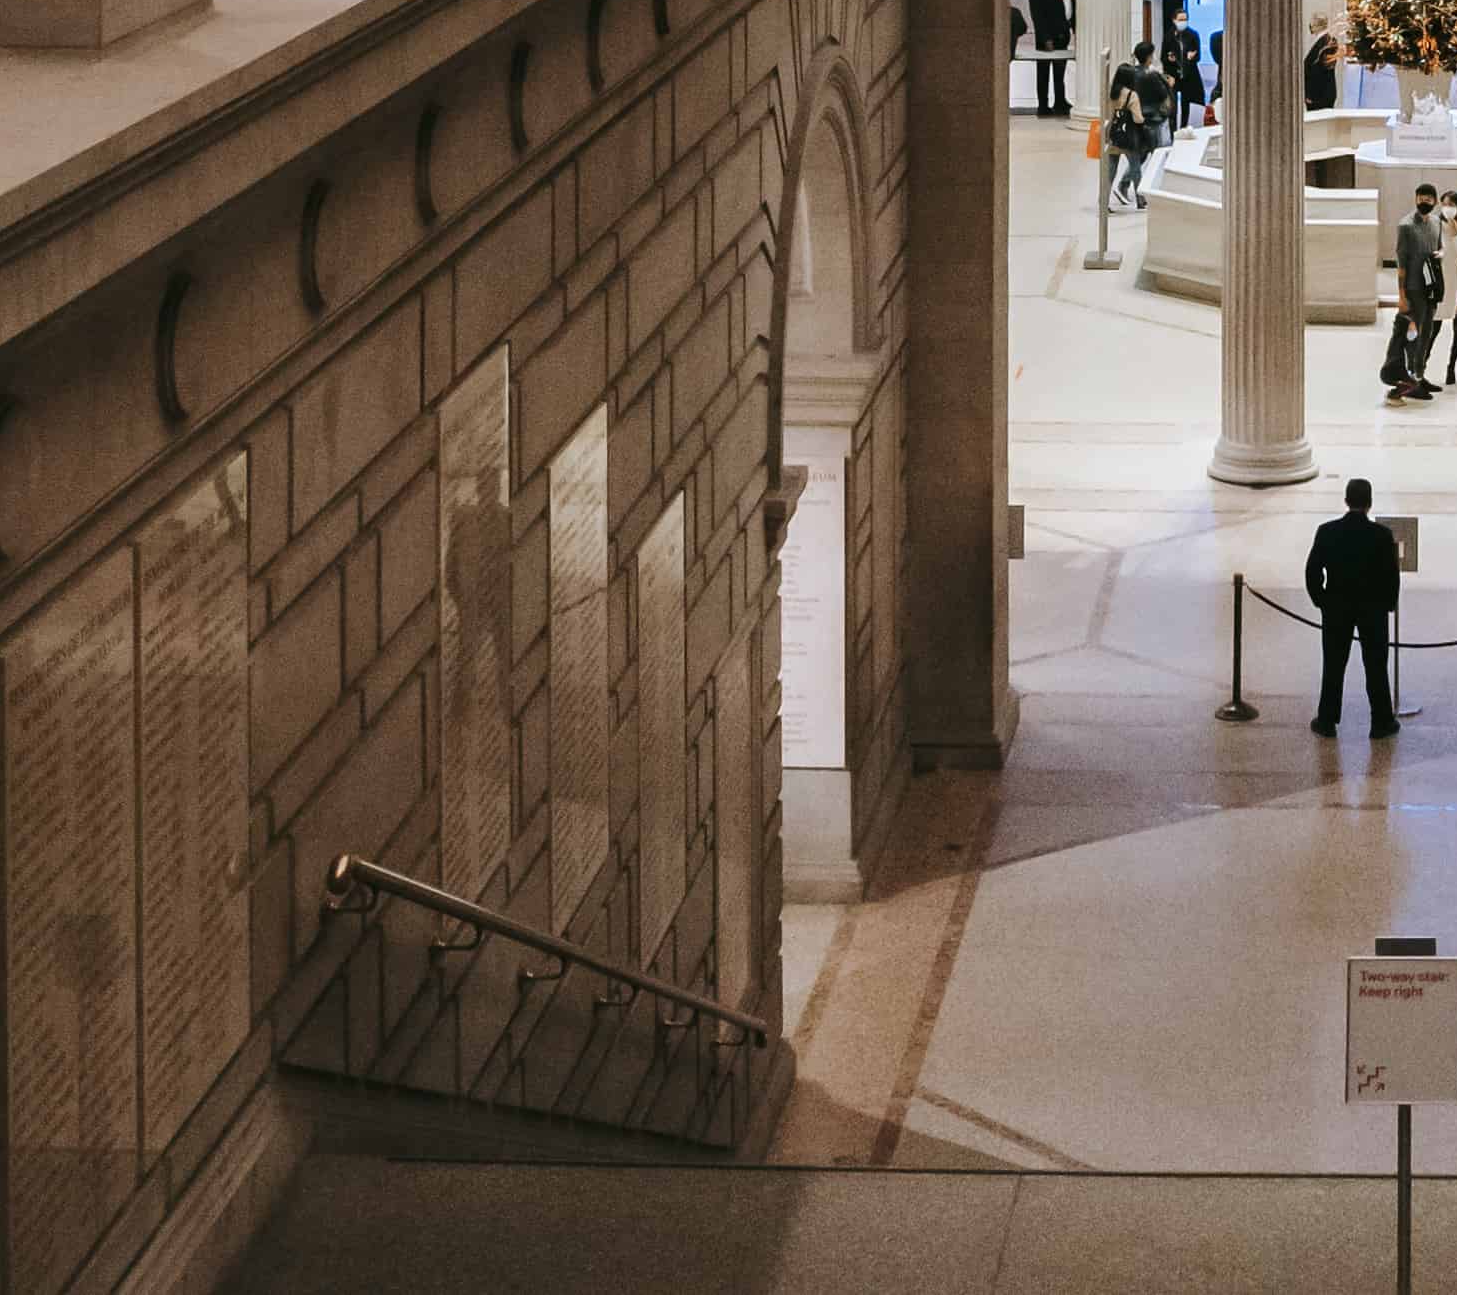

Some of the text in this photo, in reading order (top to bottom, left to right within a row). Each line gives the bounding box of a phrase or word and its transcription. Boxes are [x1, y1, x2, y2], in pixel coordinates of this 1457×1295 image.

[1360, 970, 1414, 984] Two-way
[1359, 985, 1423, 999] Keep right
